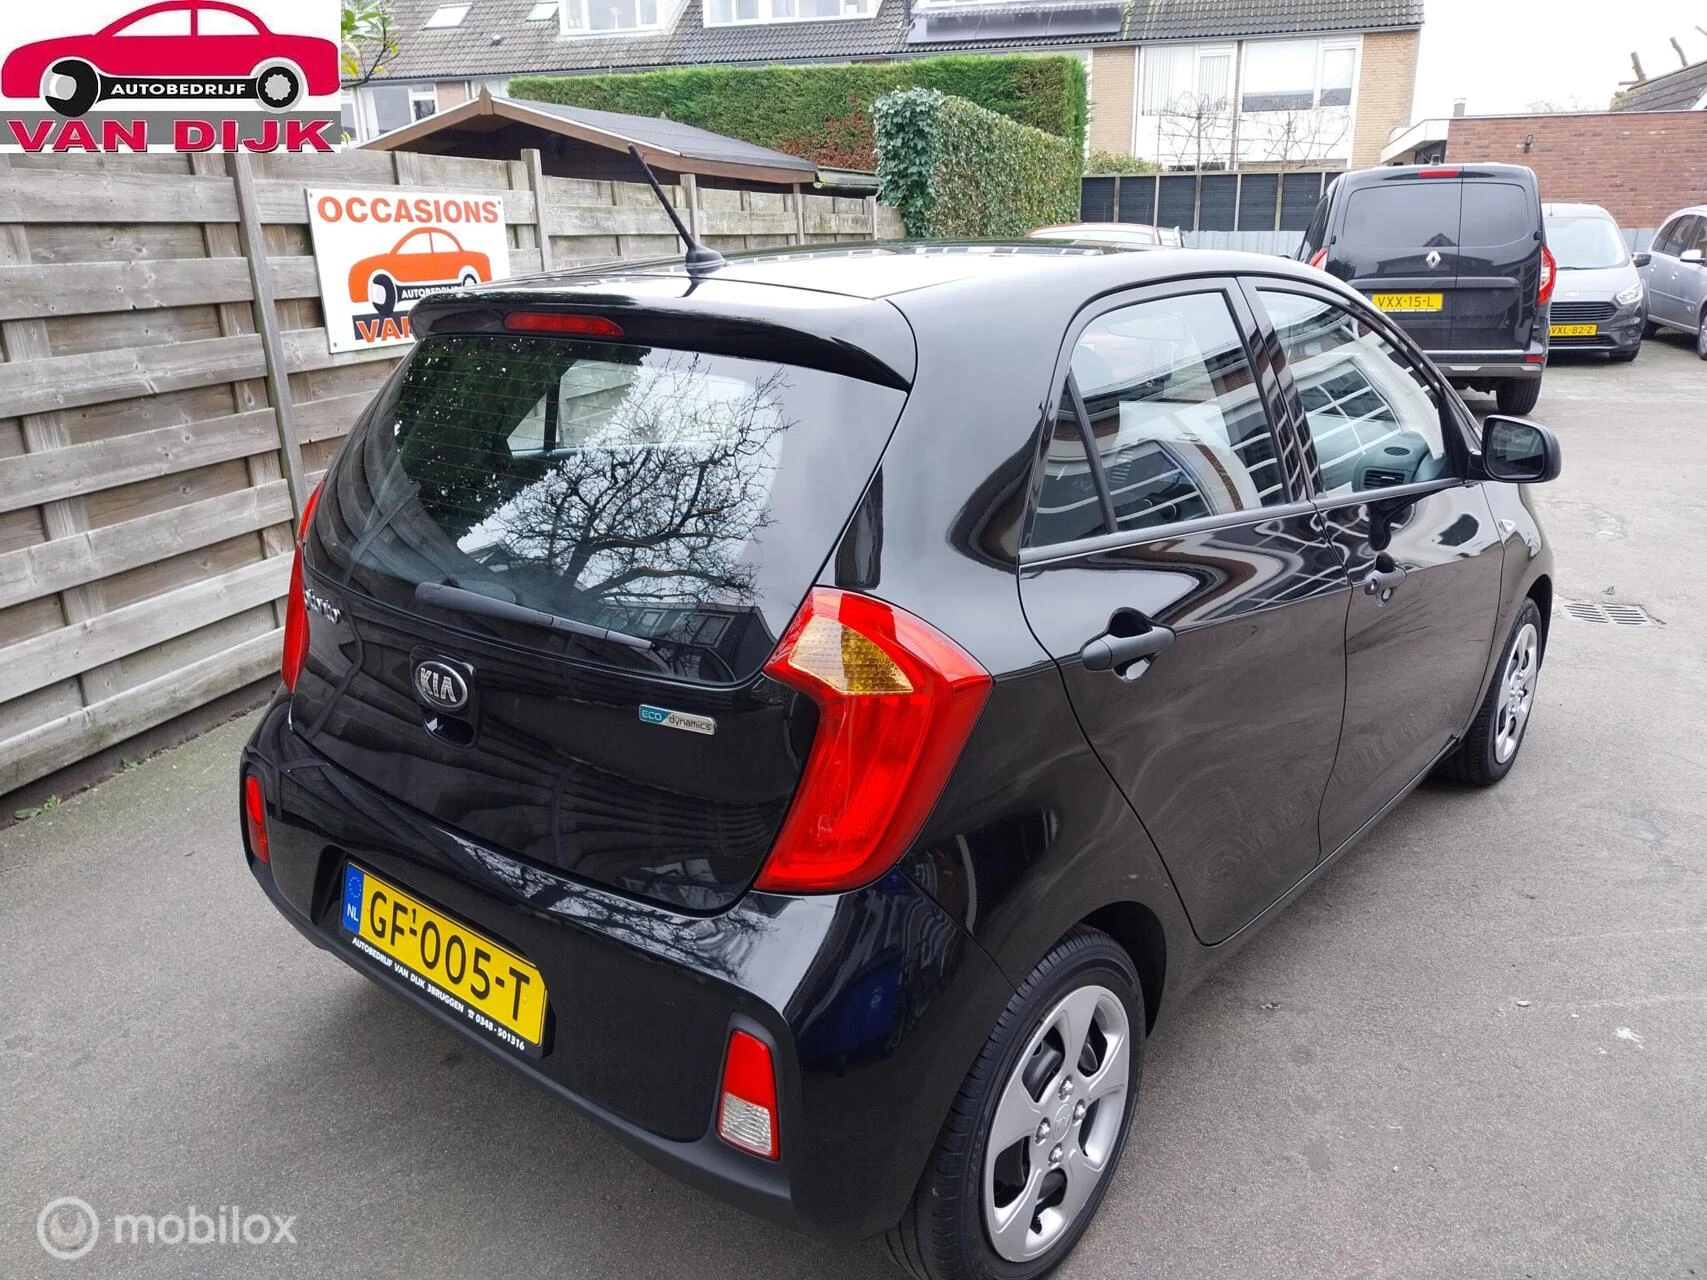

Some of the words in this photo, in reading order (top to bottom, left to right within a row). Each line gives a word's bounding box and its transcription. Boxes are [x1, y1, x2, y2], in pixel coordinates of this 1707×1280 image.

[317, 196, 499, 223] OCCASIONS
[1377, 296, 1434, 308] VXX-15-L
[420, 667, 457, 703] KIA
[641, 709, 662, 721] ECO
[668, 715, 712, 731] dynamics
[346, 903, 359, 922] NL
[352, 937, 393, 968] AUTOBEDRIJF
[394, 962, 409, 979] VAN
[410, 974, 425, 990] DIJK
[427, 983, 465, 1013] 3BRUGGEN
